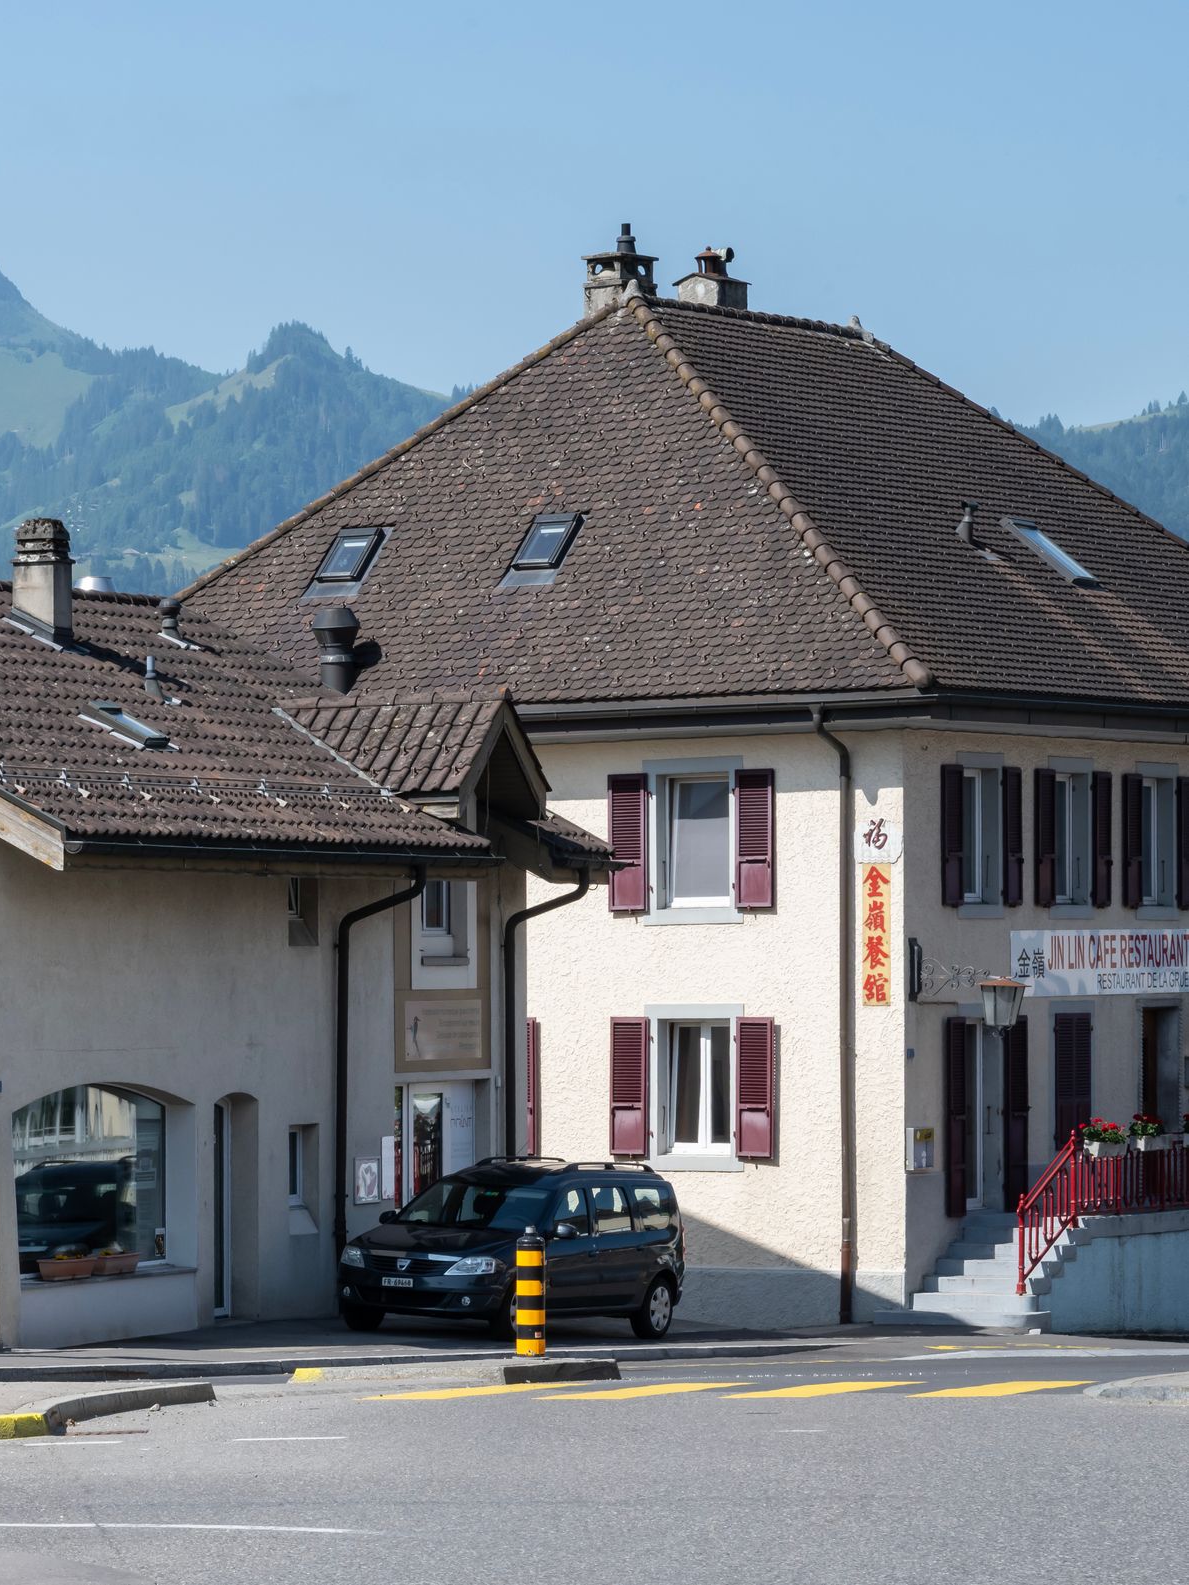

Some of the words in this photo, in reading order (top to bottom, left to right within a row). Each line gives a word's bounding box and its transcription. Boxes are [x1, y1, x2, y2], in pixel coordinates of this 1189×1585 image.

[1048, 935, 1064, 970] JIN
[1068, 935, 1085, 969] LIN
[1089, 935, 1117, 969] CAFE
[1120, 934, 1189, 968] RESTAURANT
[1097, 972, 1145, 989] RESTAURANT
[1147, 972, 1157, 988] DE
[1159, 972, 1167, 988] LA
